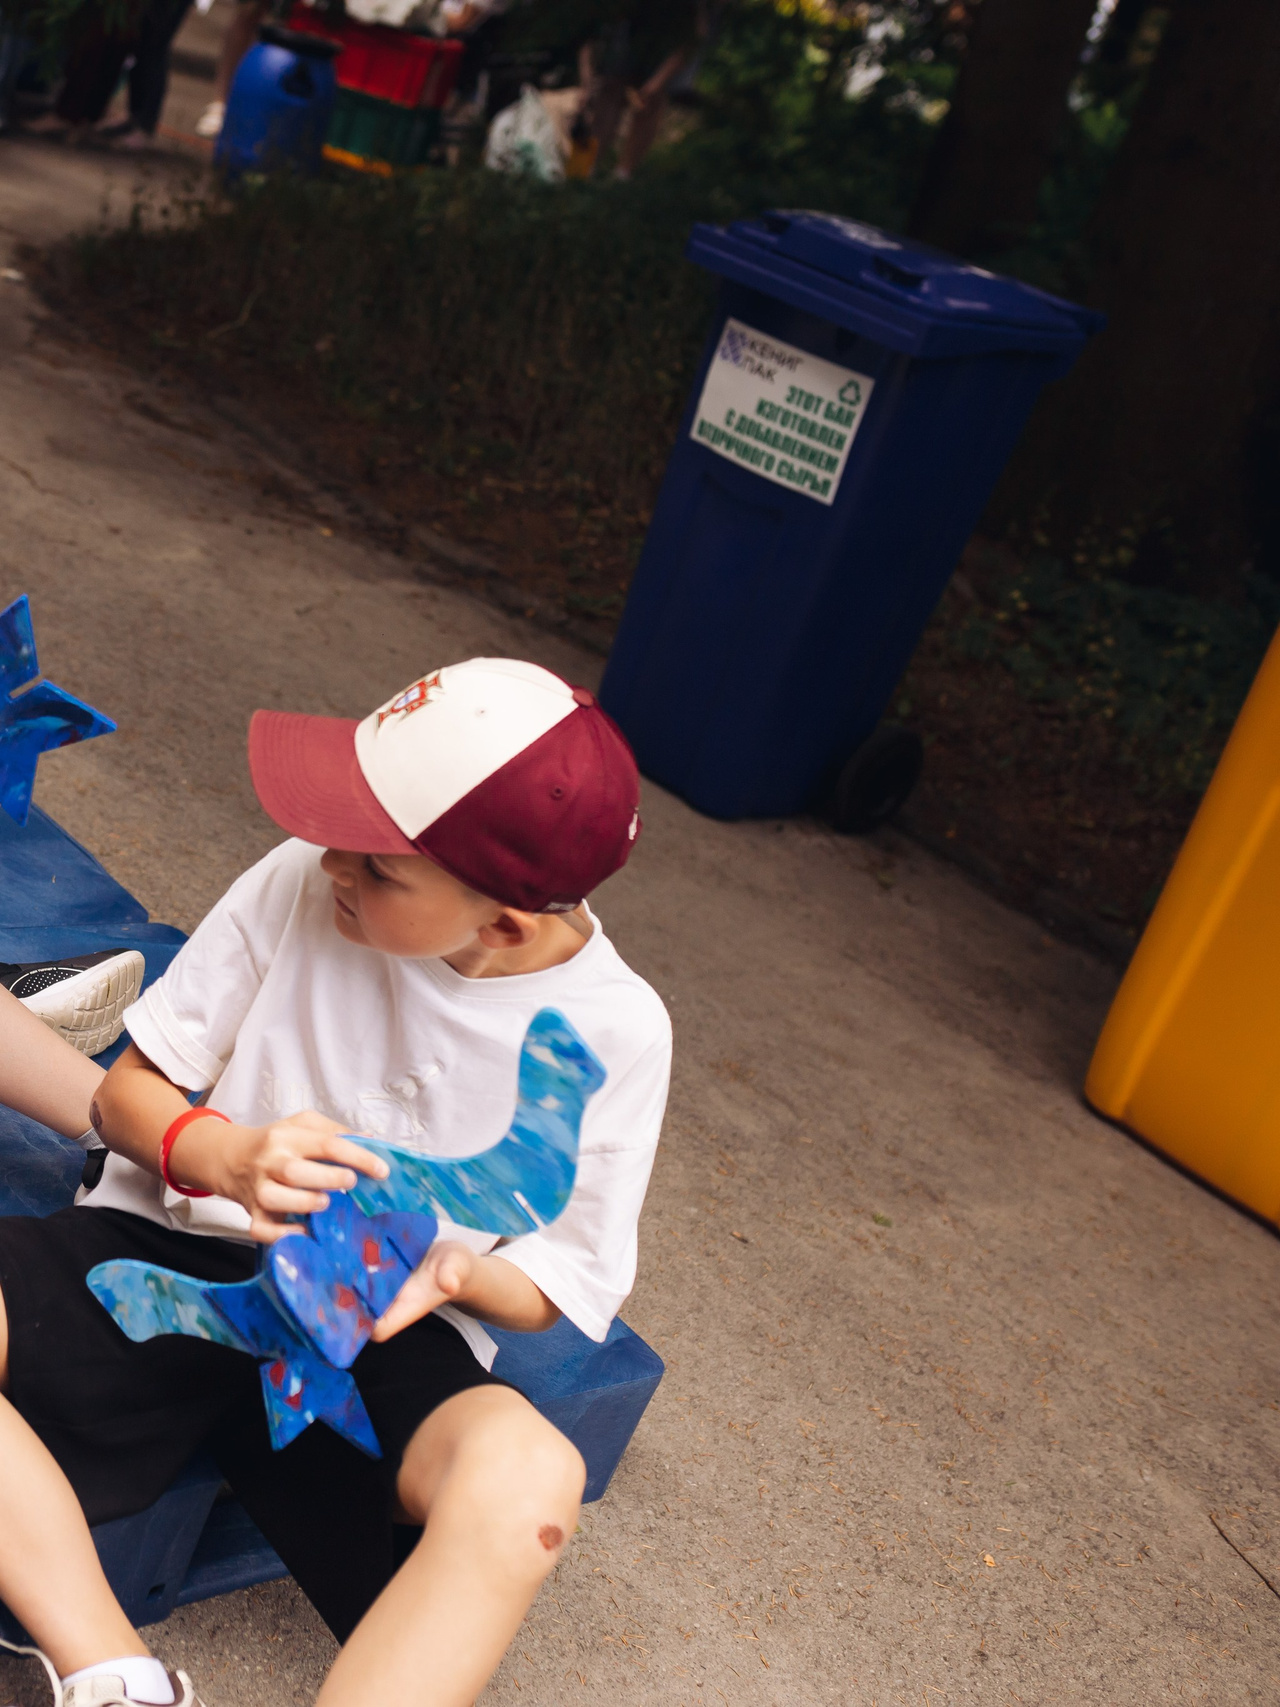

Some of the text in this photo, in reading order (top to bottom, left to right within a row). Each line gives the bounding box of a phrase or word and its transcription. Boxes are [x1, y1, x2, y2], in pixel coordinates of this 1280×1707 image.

[742, 355, 778, 383] ПАК
[756, 398, 847, 451] ИЗГОТОВЛЕН
[786, 385, 823, 415] ЭТОТ
[697, 419, 832, 497] ВТОРИЧНОГО СЫРЬЯ
[734, 414, 840, 475] ДОБАВЛЕНИЕМ
